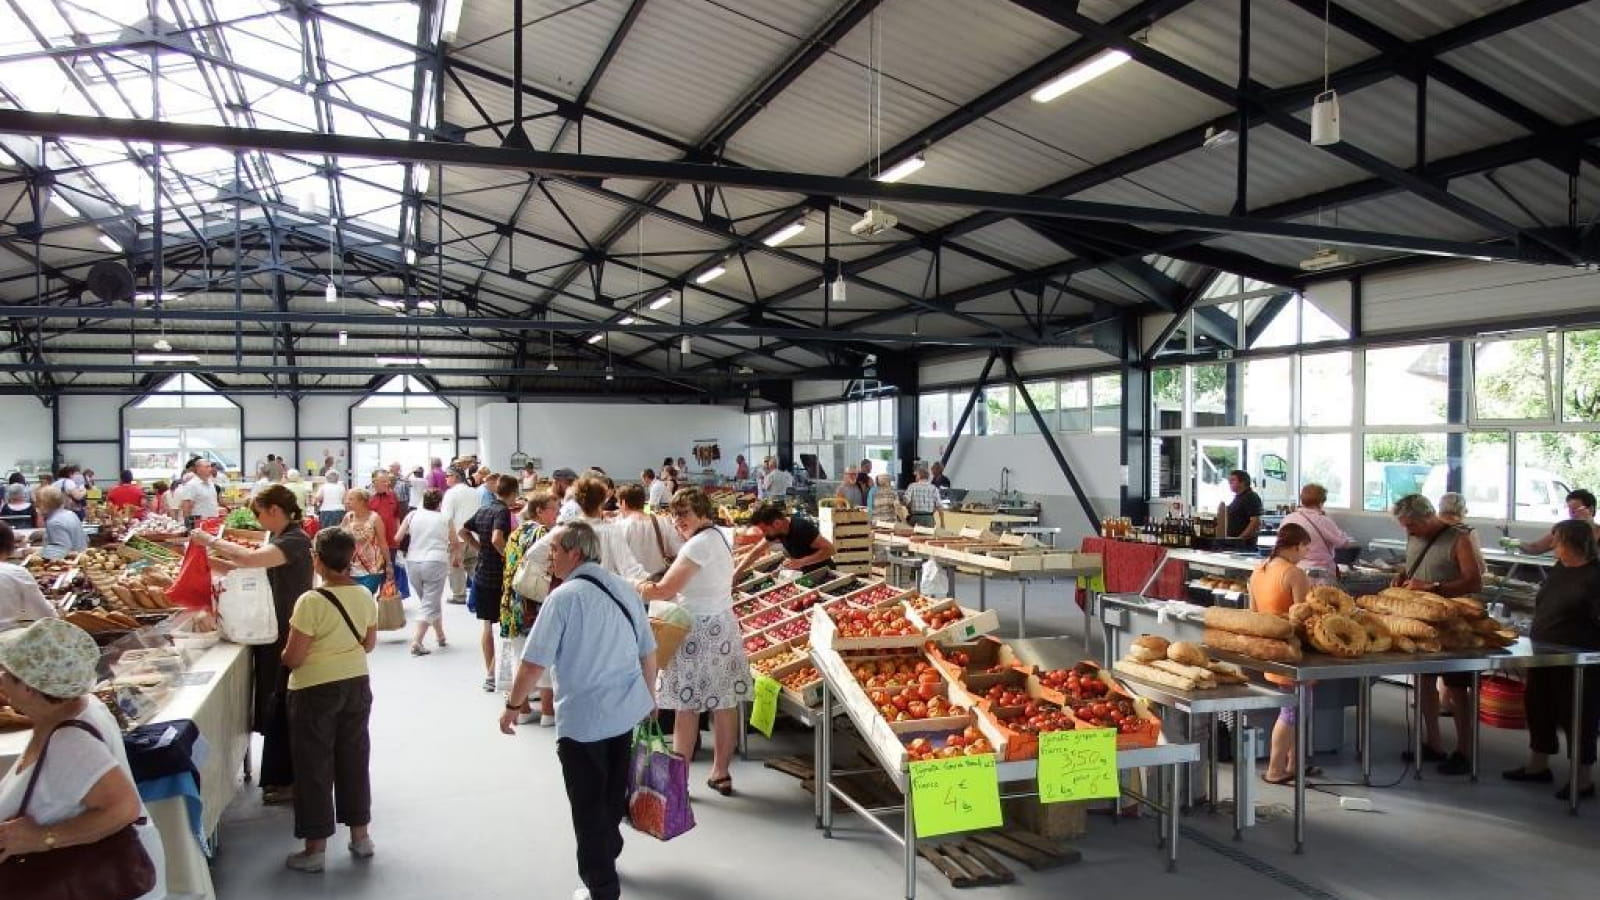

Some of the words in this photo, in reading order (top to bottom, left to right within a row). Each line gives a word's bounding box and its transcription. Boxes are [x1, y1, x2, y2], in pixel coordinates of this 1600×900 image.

[943, 786, 957, 814] 4
[957, 779, 969, 790] €
[1061, 783, 1074, 798] kg
